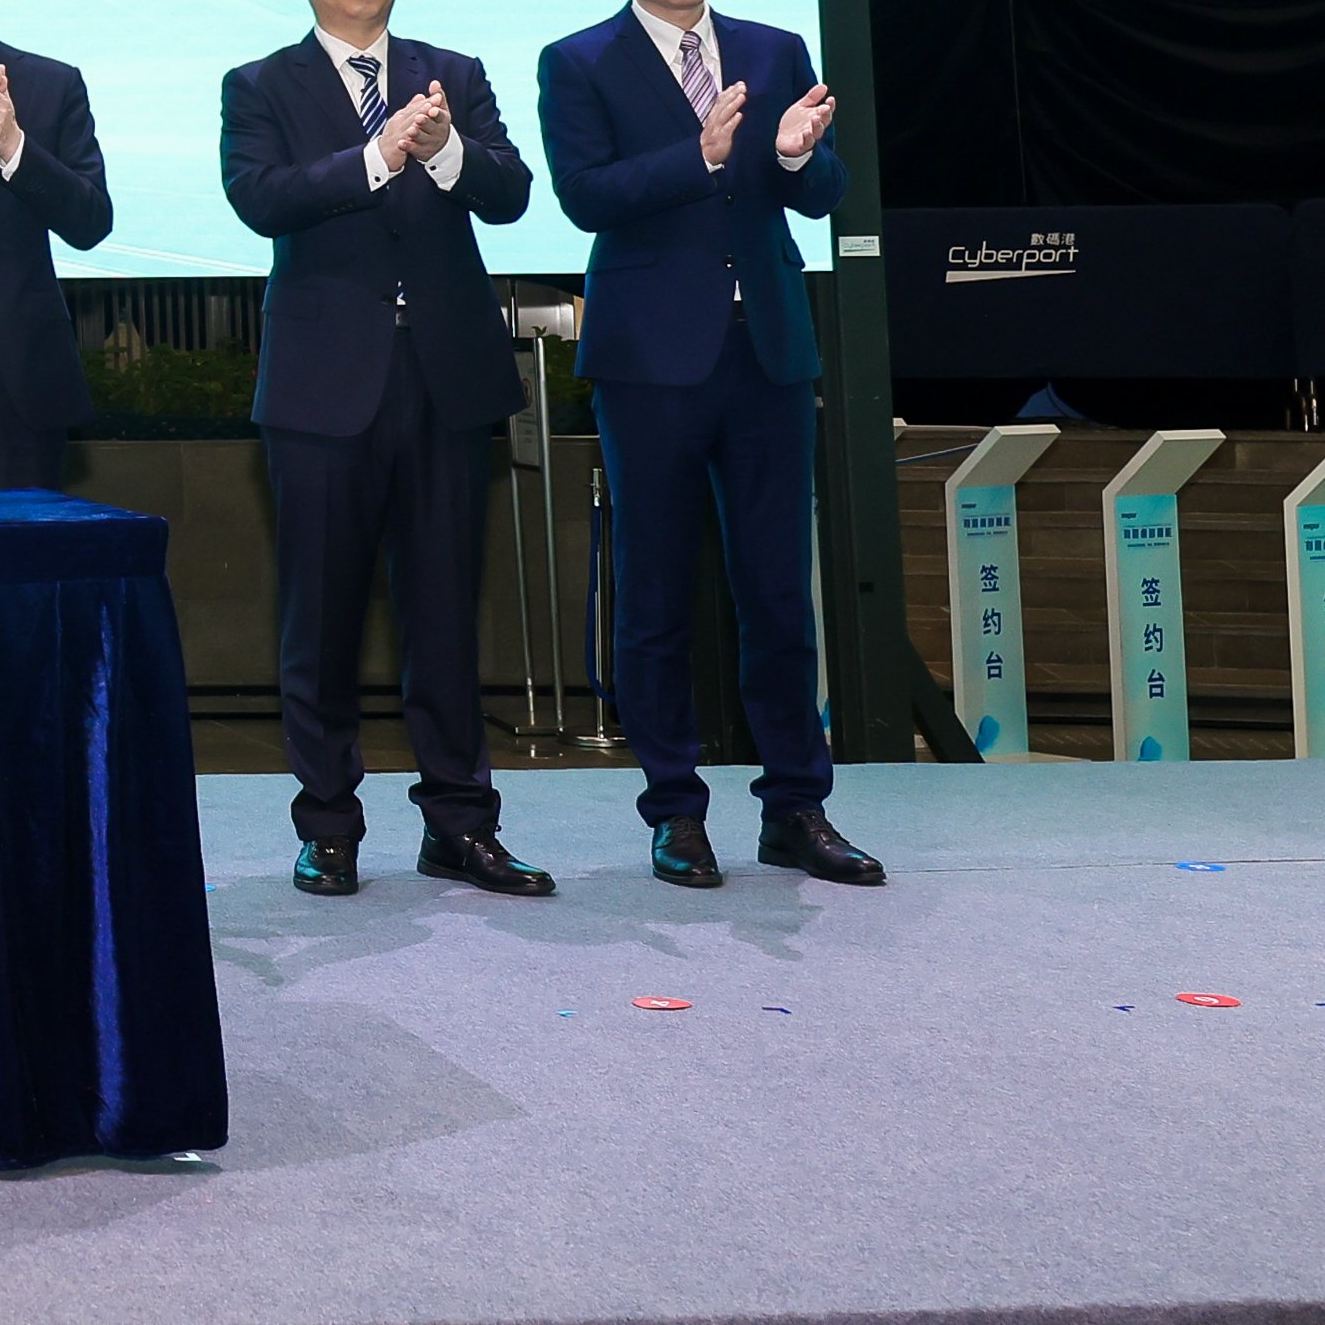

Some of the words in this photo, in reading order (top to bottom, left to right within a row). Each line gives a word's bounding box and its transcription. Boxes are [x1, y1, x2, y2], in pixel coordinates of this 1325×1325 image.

[947, 240, 1080, 272] Cyberport
[1031, 232, 1075, 246] 數碼港
[979, 563, 1005, 680] 签约台
[1140, 577, 1167, 699] 签约台
